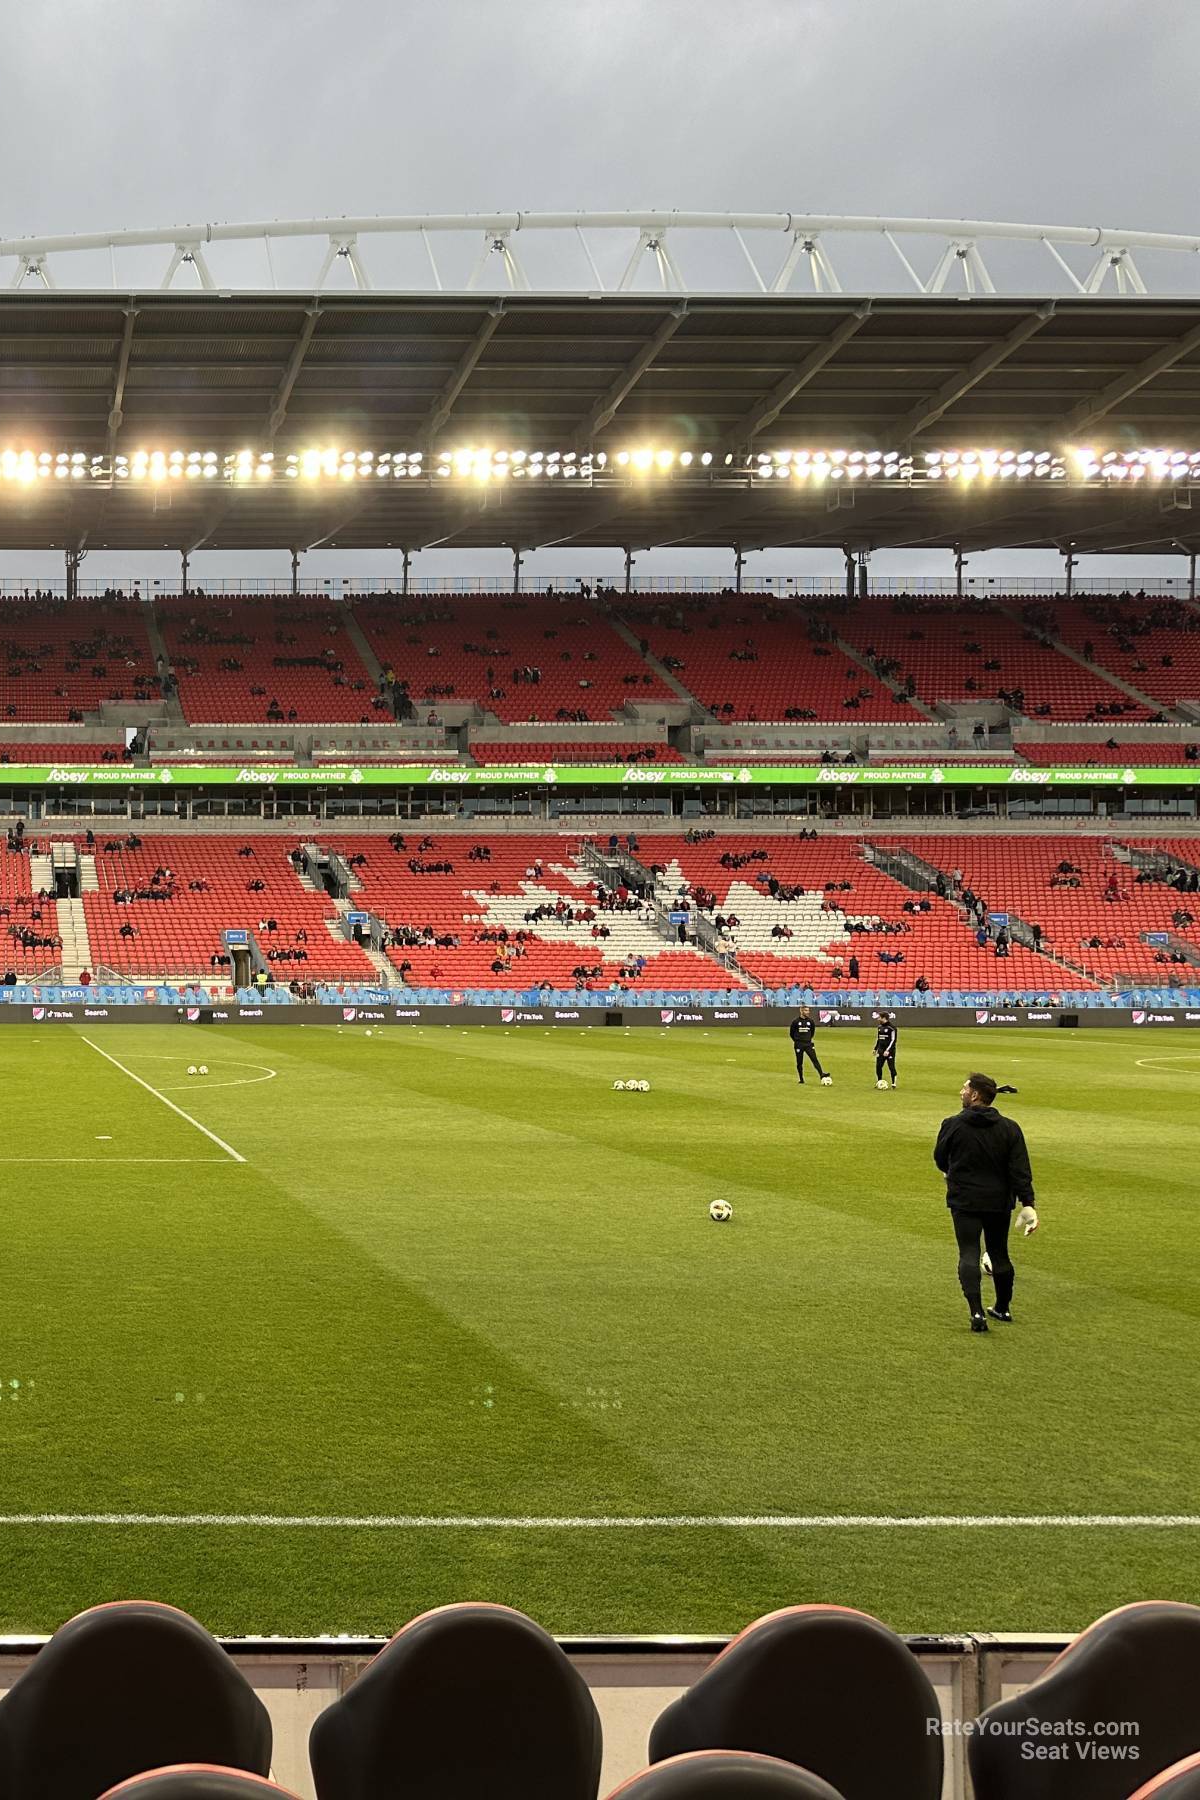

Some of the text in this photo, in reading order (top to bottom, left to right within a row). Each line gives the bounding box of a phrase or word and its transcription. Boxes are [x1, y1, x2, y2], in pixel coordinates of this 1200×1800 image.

[47, 768, 156, 783] Sobeys PROUD PARTNER
[236, 768, 346, 783] Sobeys PROUD PARTNER
[427, 768, 539, 783] Sobeys PROUD PARTNER
[623, 767, 667, 782] Sobeys
[670, 771, 697, 779] PROUD
[816, 768, 927, 783] Sobeys PROUD PARTNER
[1008, 768, 1119, 783] Sobeys PROUD PARTNER
[84, 1009, 109, 1017] Search
[239, 1009, 263, 1017] Search
[396, 1009, 420, 1017] Search
[555, 1010, 579, 1020] Search
[714, 1011, 739, 1020] Search
[1027, 1012, 1052, 1020] Search
